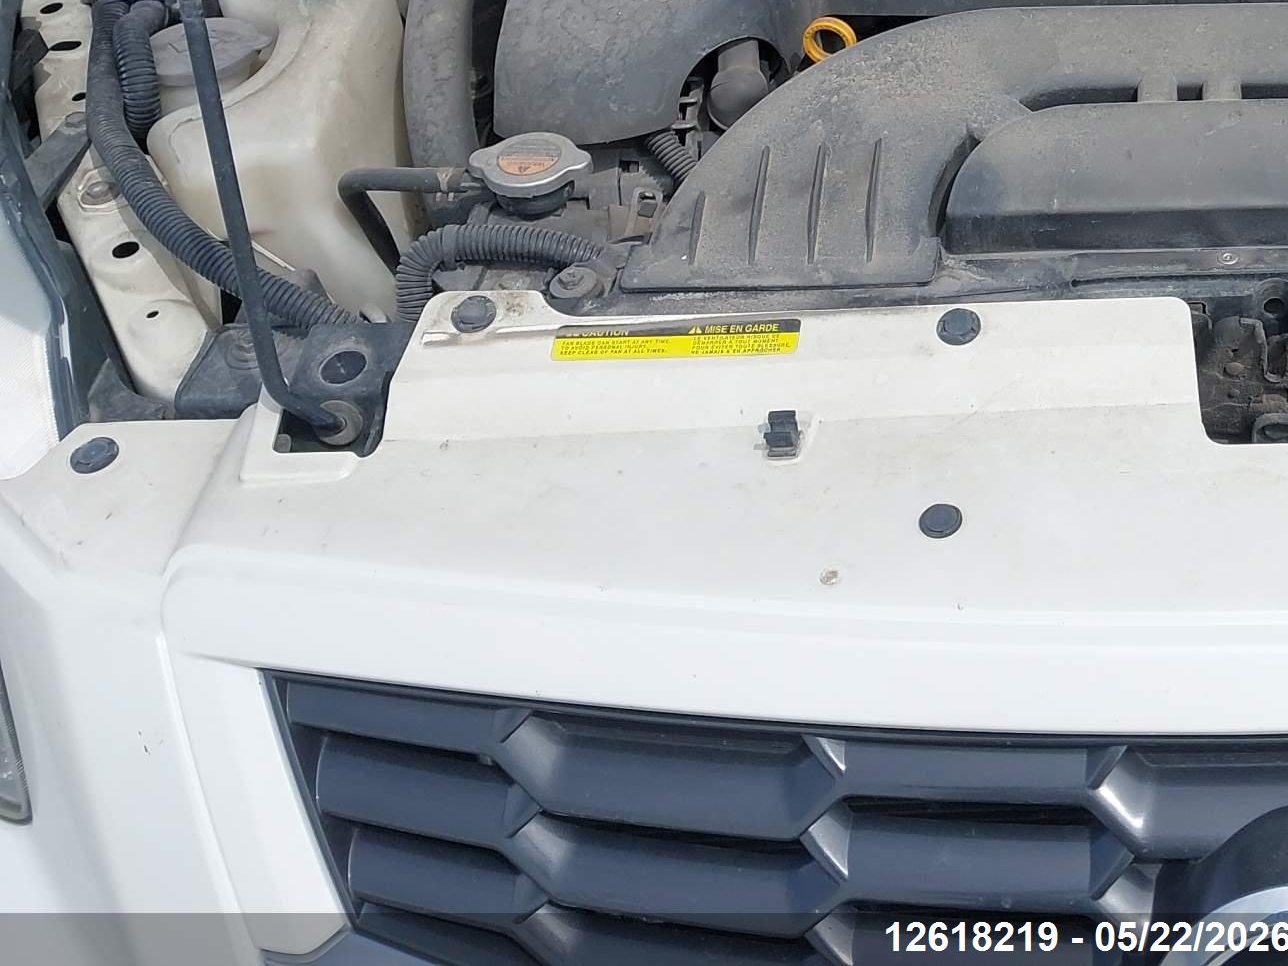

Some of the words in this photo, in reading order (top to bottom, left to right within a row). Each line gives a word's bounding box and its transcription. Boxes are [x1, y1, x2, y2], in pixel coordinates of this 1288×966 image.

[705, 325, 728, 334] MISE
[729, 324, 743, 333] EN
[745, 323, 780, 332] GARDE
